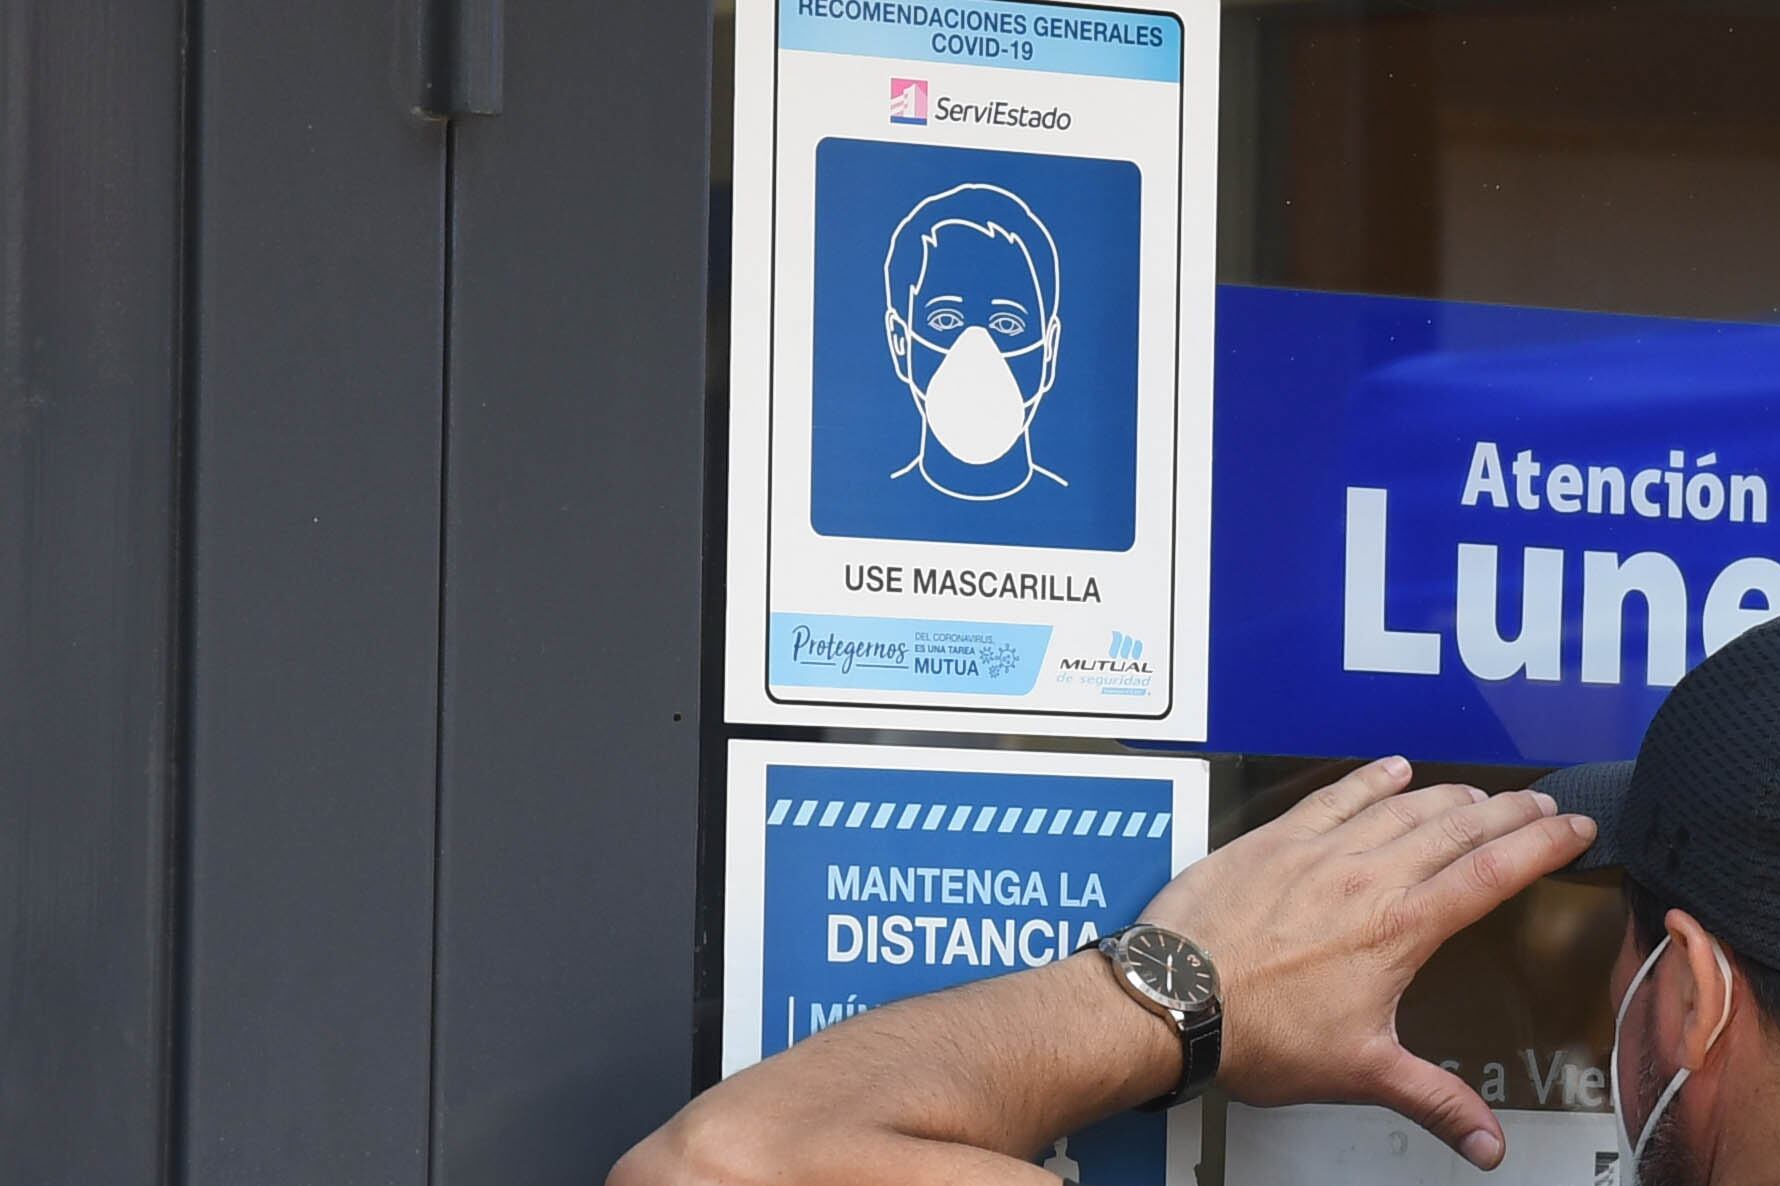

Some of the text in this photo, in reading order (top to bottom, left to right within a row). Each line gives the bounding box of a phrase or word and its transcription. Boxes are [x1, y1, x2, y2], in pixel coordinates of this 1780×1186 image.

[798, 0, 1164, 47] RECOMENDACIONES GENERALES
[931, 33, 1034, 61] COVID-19
[934, 97, 1072, 131] ServiEstado
[1461, 441, 1769, 524] Atención
[844, 564, 1102, 603] USE MASCARILLA
[792, 624, 909, 675] Protegernos
[914, 631, 930, 642] DEL
[914, 643, 976, 656] ES UNA TAREA
[914, 657, 979, 677] MUTUA
[1059, 658, 1154, 674] MUTUAL
[827, 864, 1107, 909] MANTENGA LA
[1523, 1047, 1613, 1108] Vie
